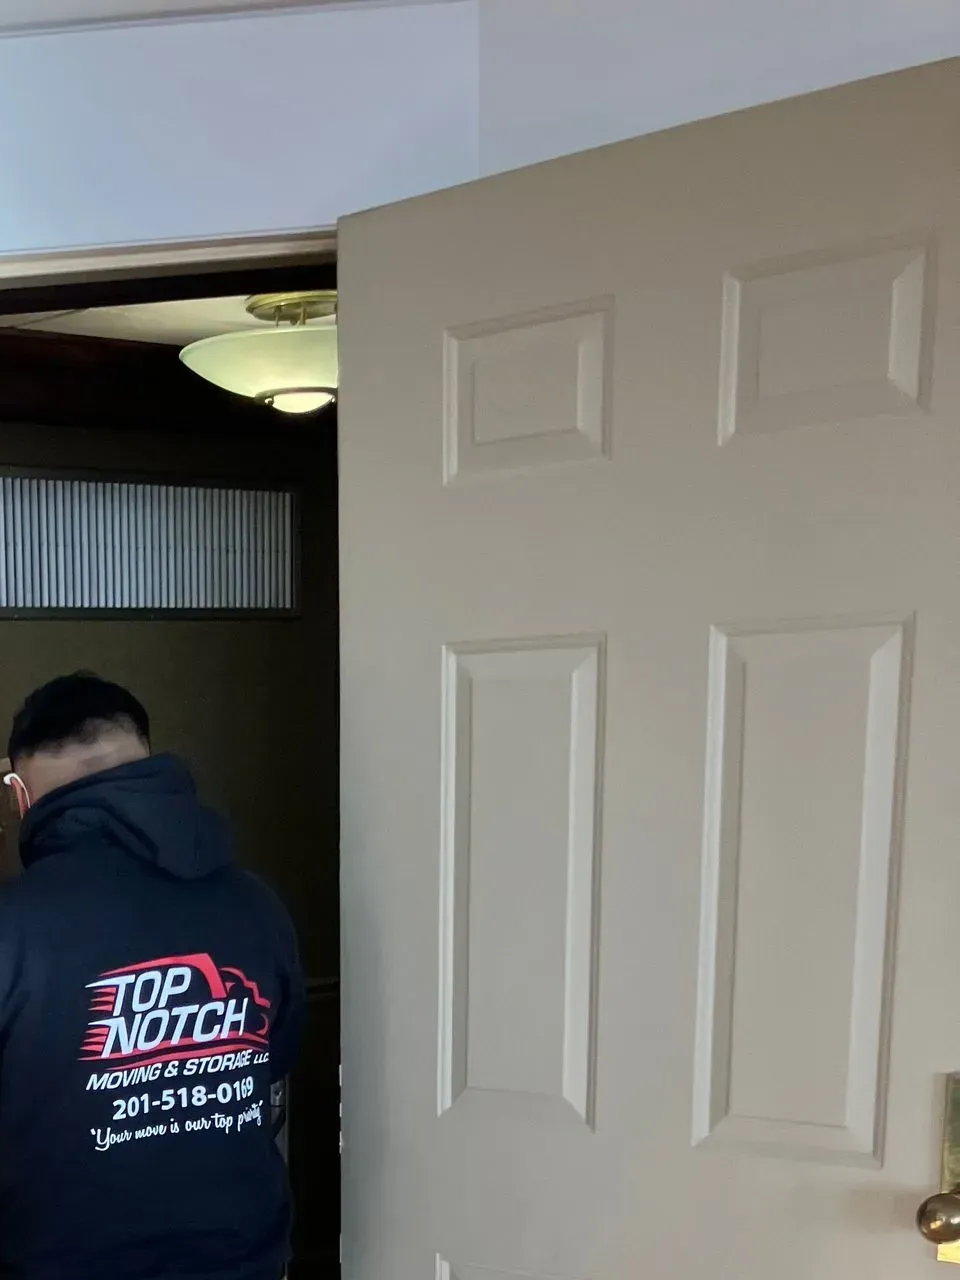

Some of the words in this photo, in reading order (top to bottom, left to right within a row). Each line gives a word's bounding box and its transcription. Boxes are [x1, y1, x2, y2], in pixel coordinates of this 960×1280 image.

[84, 966, 192, 1017] TOP
[88, 998, 249, 1059] NOTCH
[86, 1062, 161, 1091] MOVING
[163, 1060, 178, 1078] &
[183, 1049, 252, 1076] STORAGE
[112, 1076, 254, 1121] 201-518-0169
[135, 1124, 167, 1140] move
[170, 1118, 180, 1134] is
[184, 1116, 211, 1132] our
[211, 1111, 234, 1134] top
